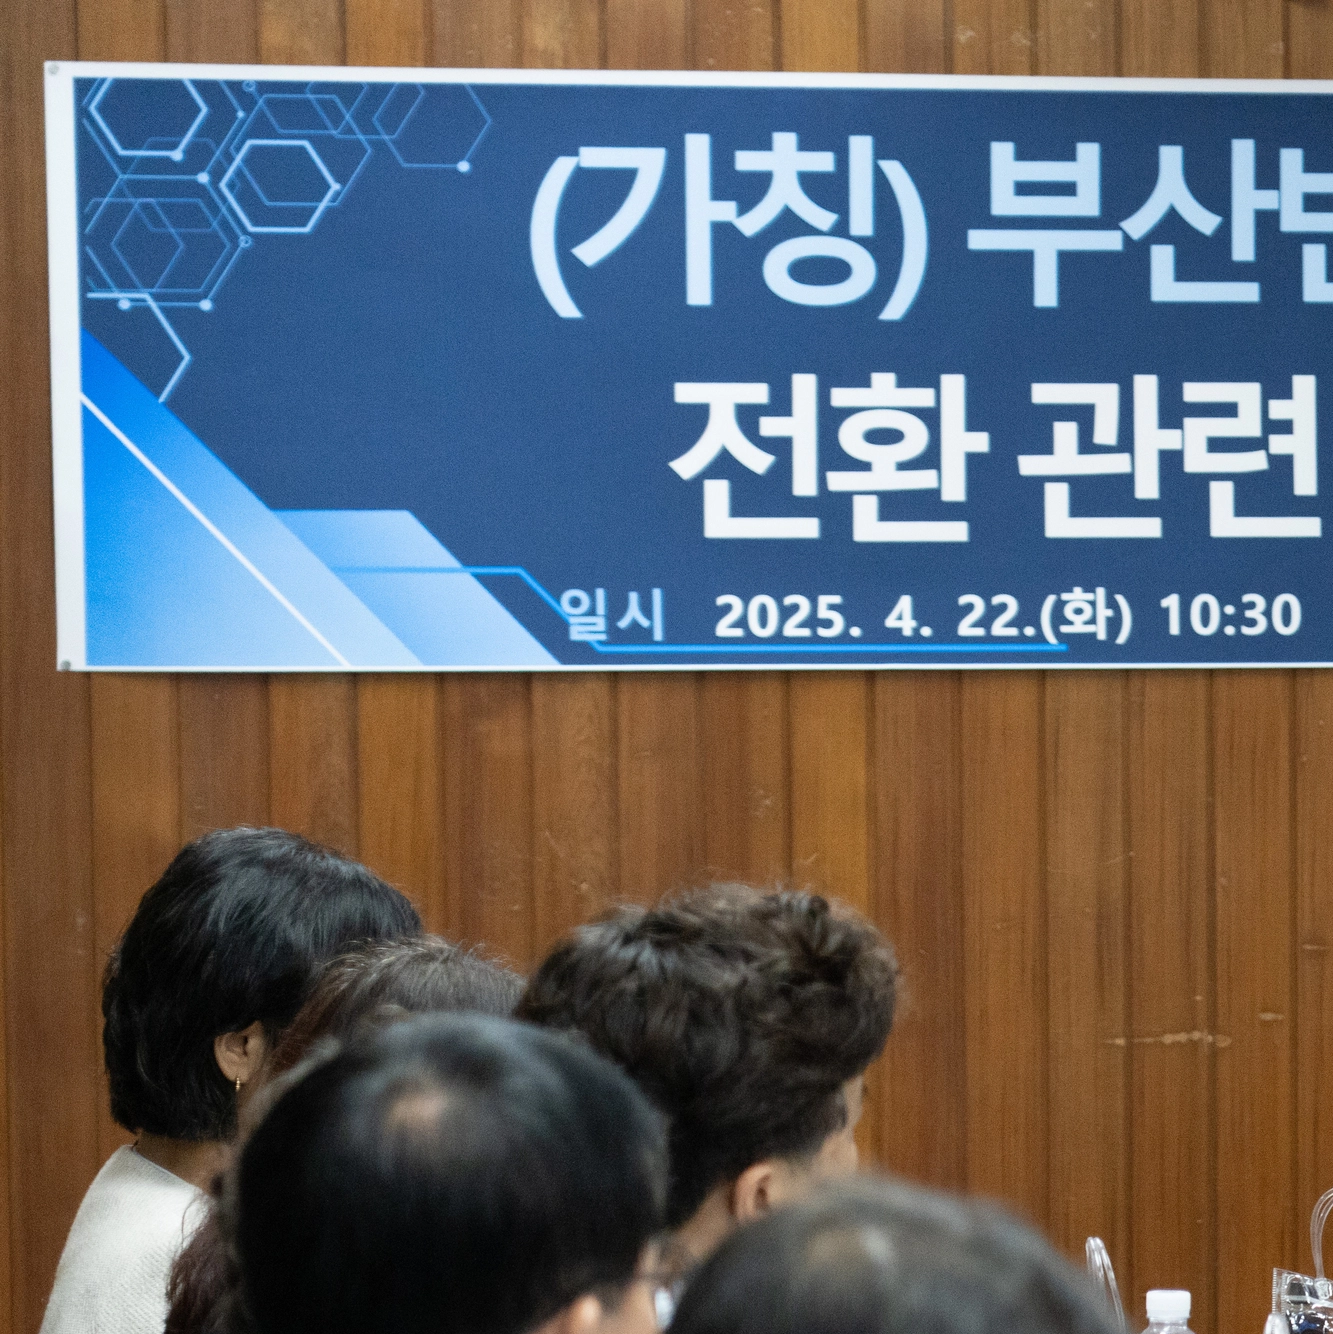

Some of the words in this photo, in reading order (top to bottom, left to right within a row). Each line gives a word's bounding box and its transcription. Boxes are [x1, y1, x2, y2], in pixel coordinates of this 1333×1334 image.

[531, 131, 927, 319] (가칭)
[669, 373, 989, 541] 전환
[1018, 373, 1322, 538] 관련
[559, 587, 665, 641] 일시
[715, 594, 862, 638] 2025.
[885, 594, 932, 637] 4.
[957, 587, 1132, 645] 22.(화)
[1160, 593, 1302, 636] 10:30
